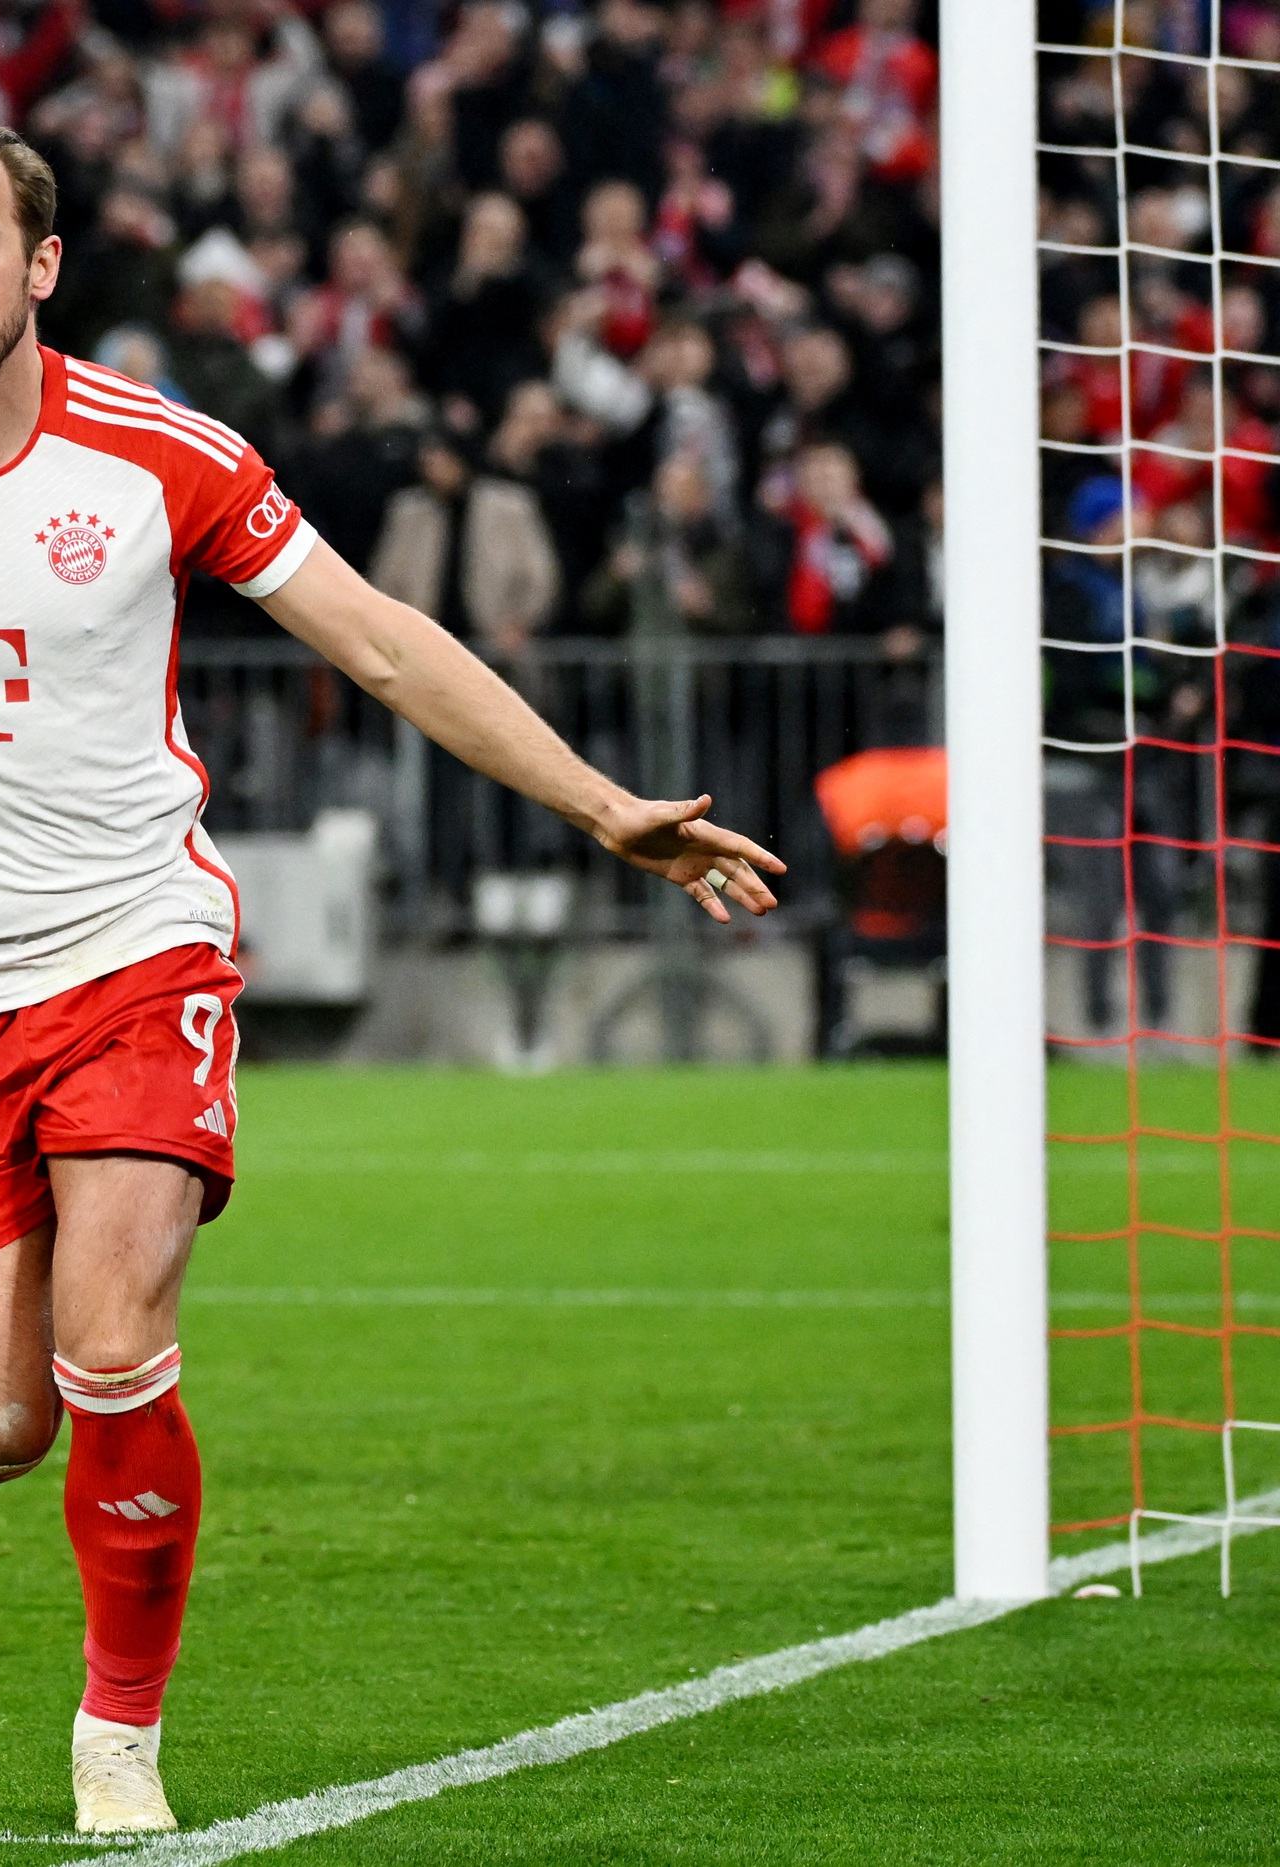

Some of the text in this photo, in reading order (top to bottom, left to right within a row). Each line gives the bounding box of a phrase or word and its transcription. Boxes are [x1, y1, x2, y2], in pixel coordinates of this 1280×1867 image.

[53, 531, 101, 553] FC BAYERN
[181, 993, 223, 1087] 9
